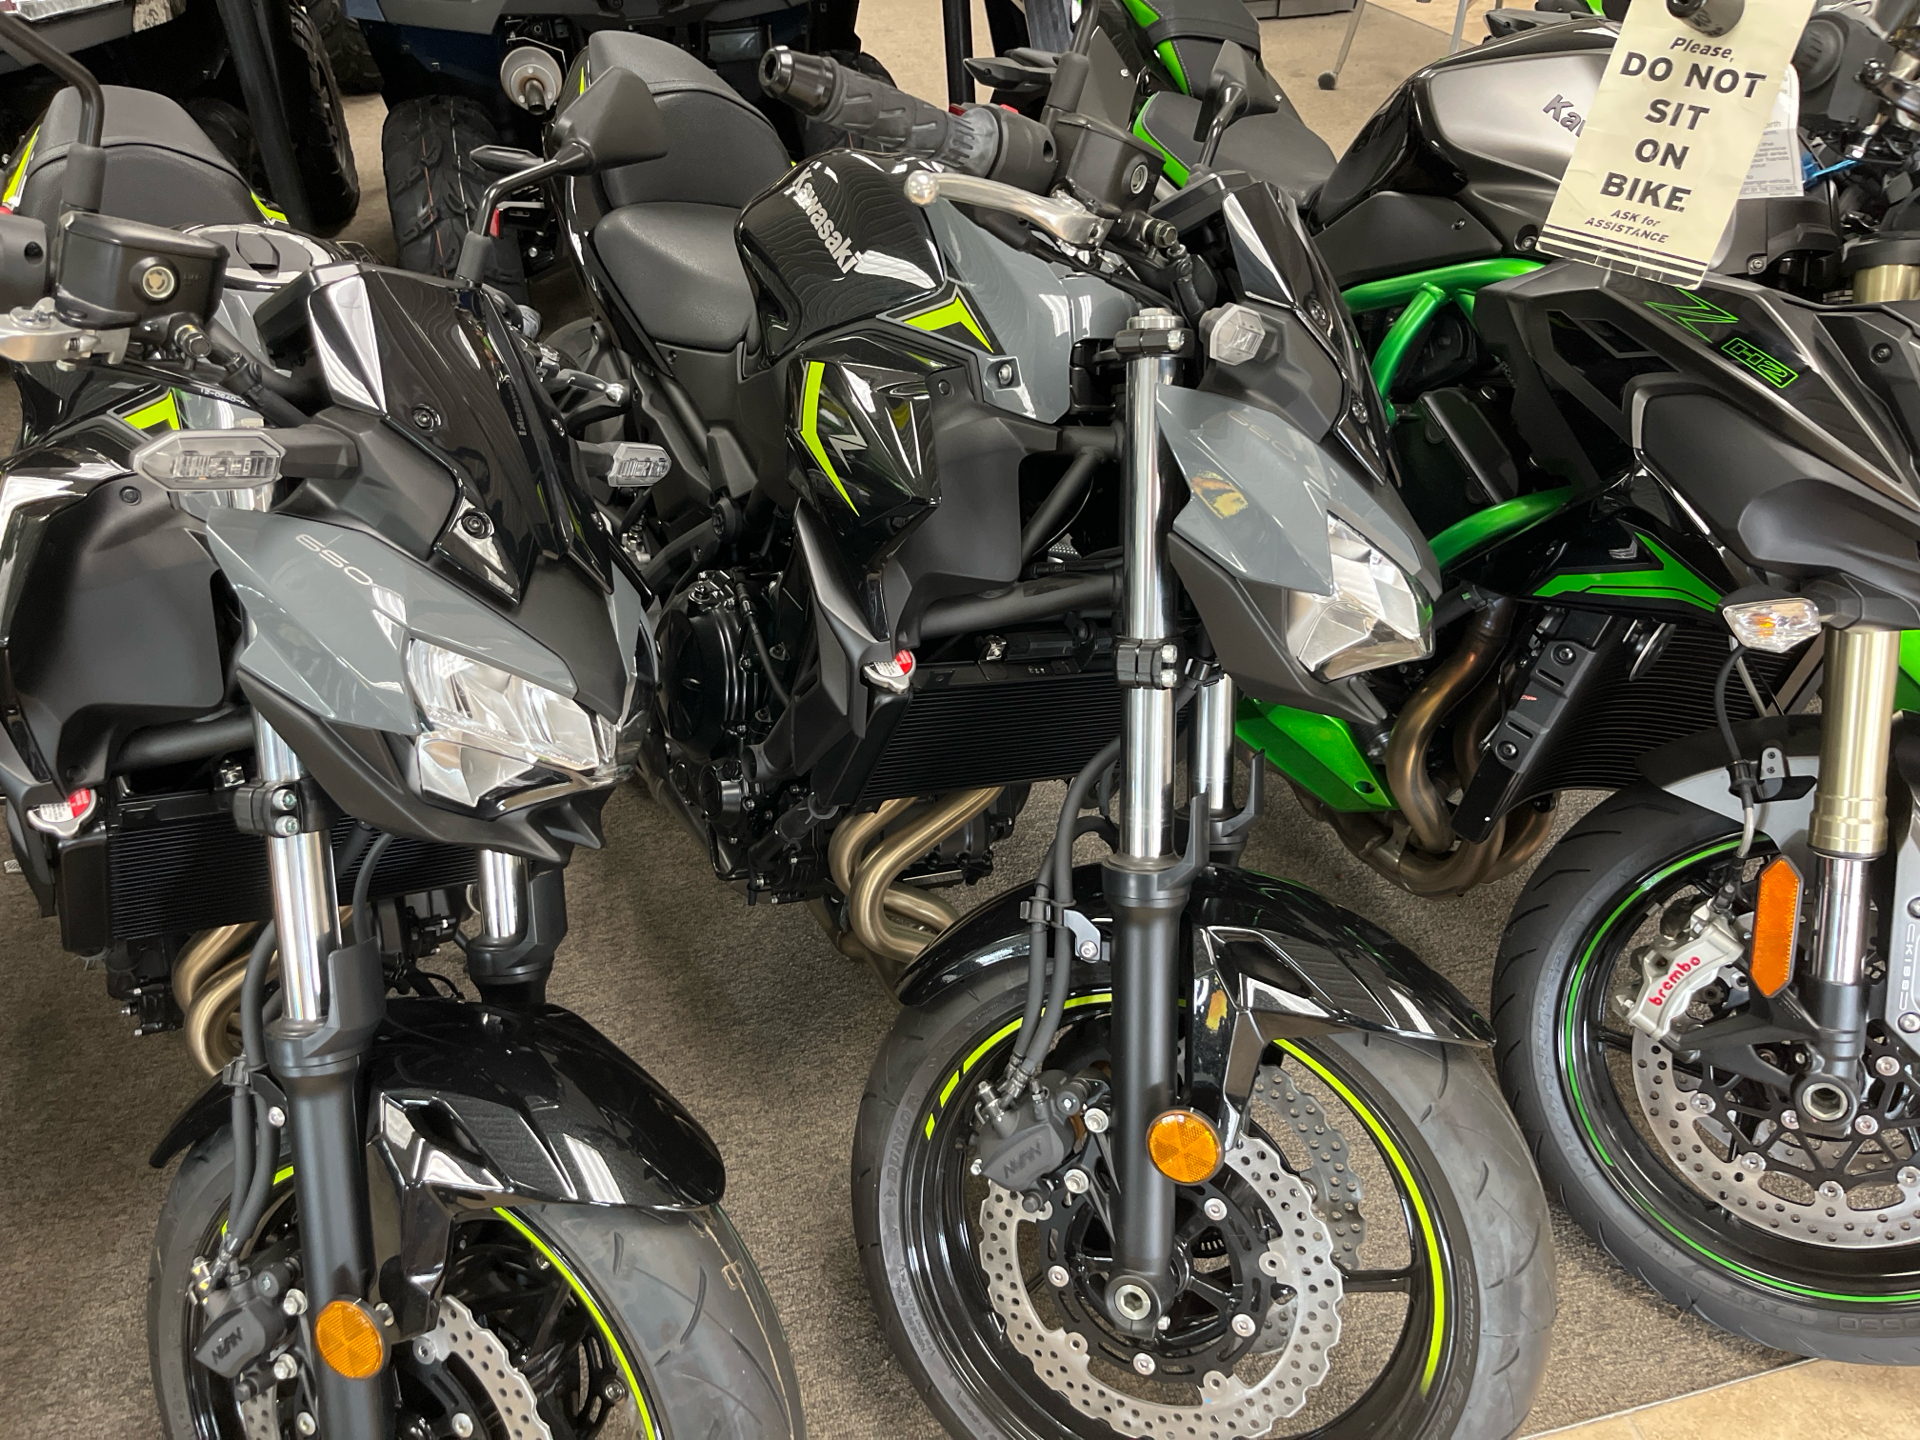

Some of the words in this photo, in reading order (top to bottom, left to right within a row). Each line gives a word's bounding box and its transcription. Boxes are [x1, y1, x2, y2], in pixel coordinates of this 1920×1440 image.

[1670, 36, 1735, 62] Please,
[1620, 51, 1673, 82] DO
[1684, 62, 1767, 98] NOT
[1542, 94, 1586, 138] Ka
[1644, 98, 1710, 130] SIT
[1635, 138, 1690, 170] ON
[1600, 171, 1691, 213] BIKE
[792, 167, 861, 274] Kawasaki
[1585, 217, 1669, 244] ASSISTANCE
[1611, 209, 1641, 223] ASK
[1641, 215, 1660, 227] for
[295, 533, 374, 586] 650
[1647, 956, 1701, 1006] brembo
